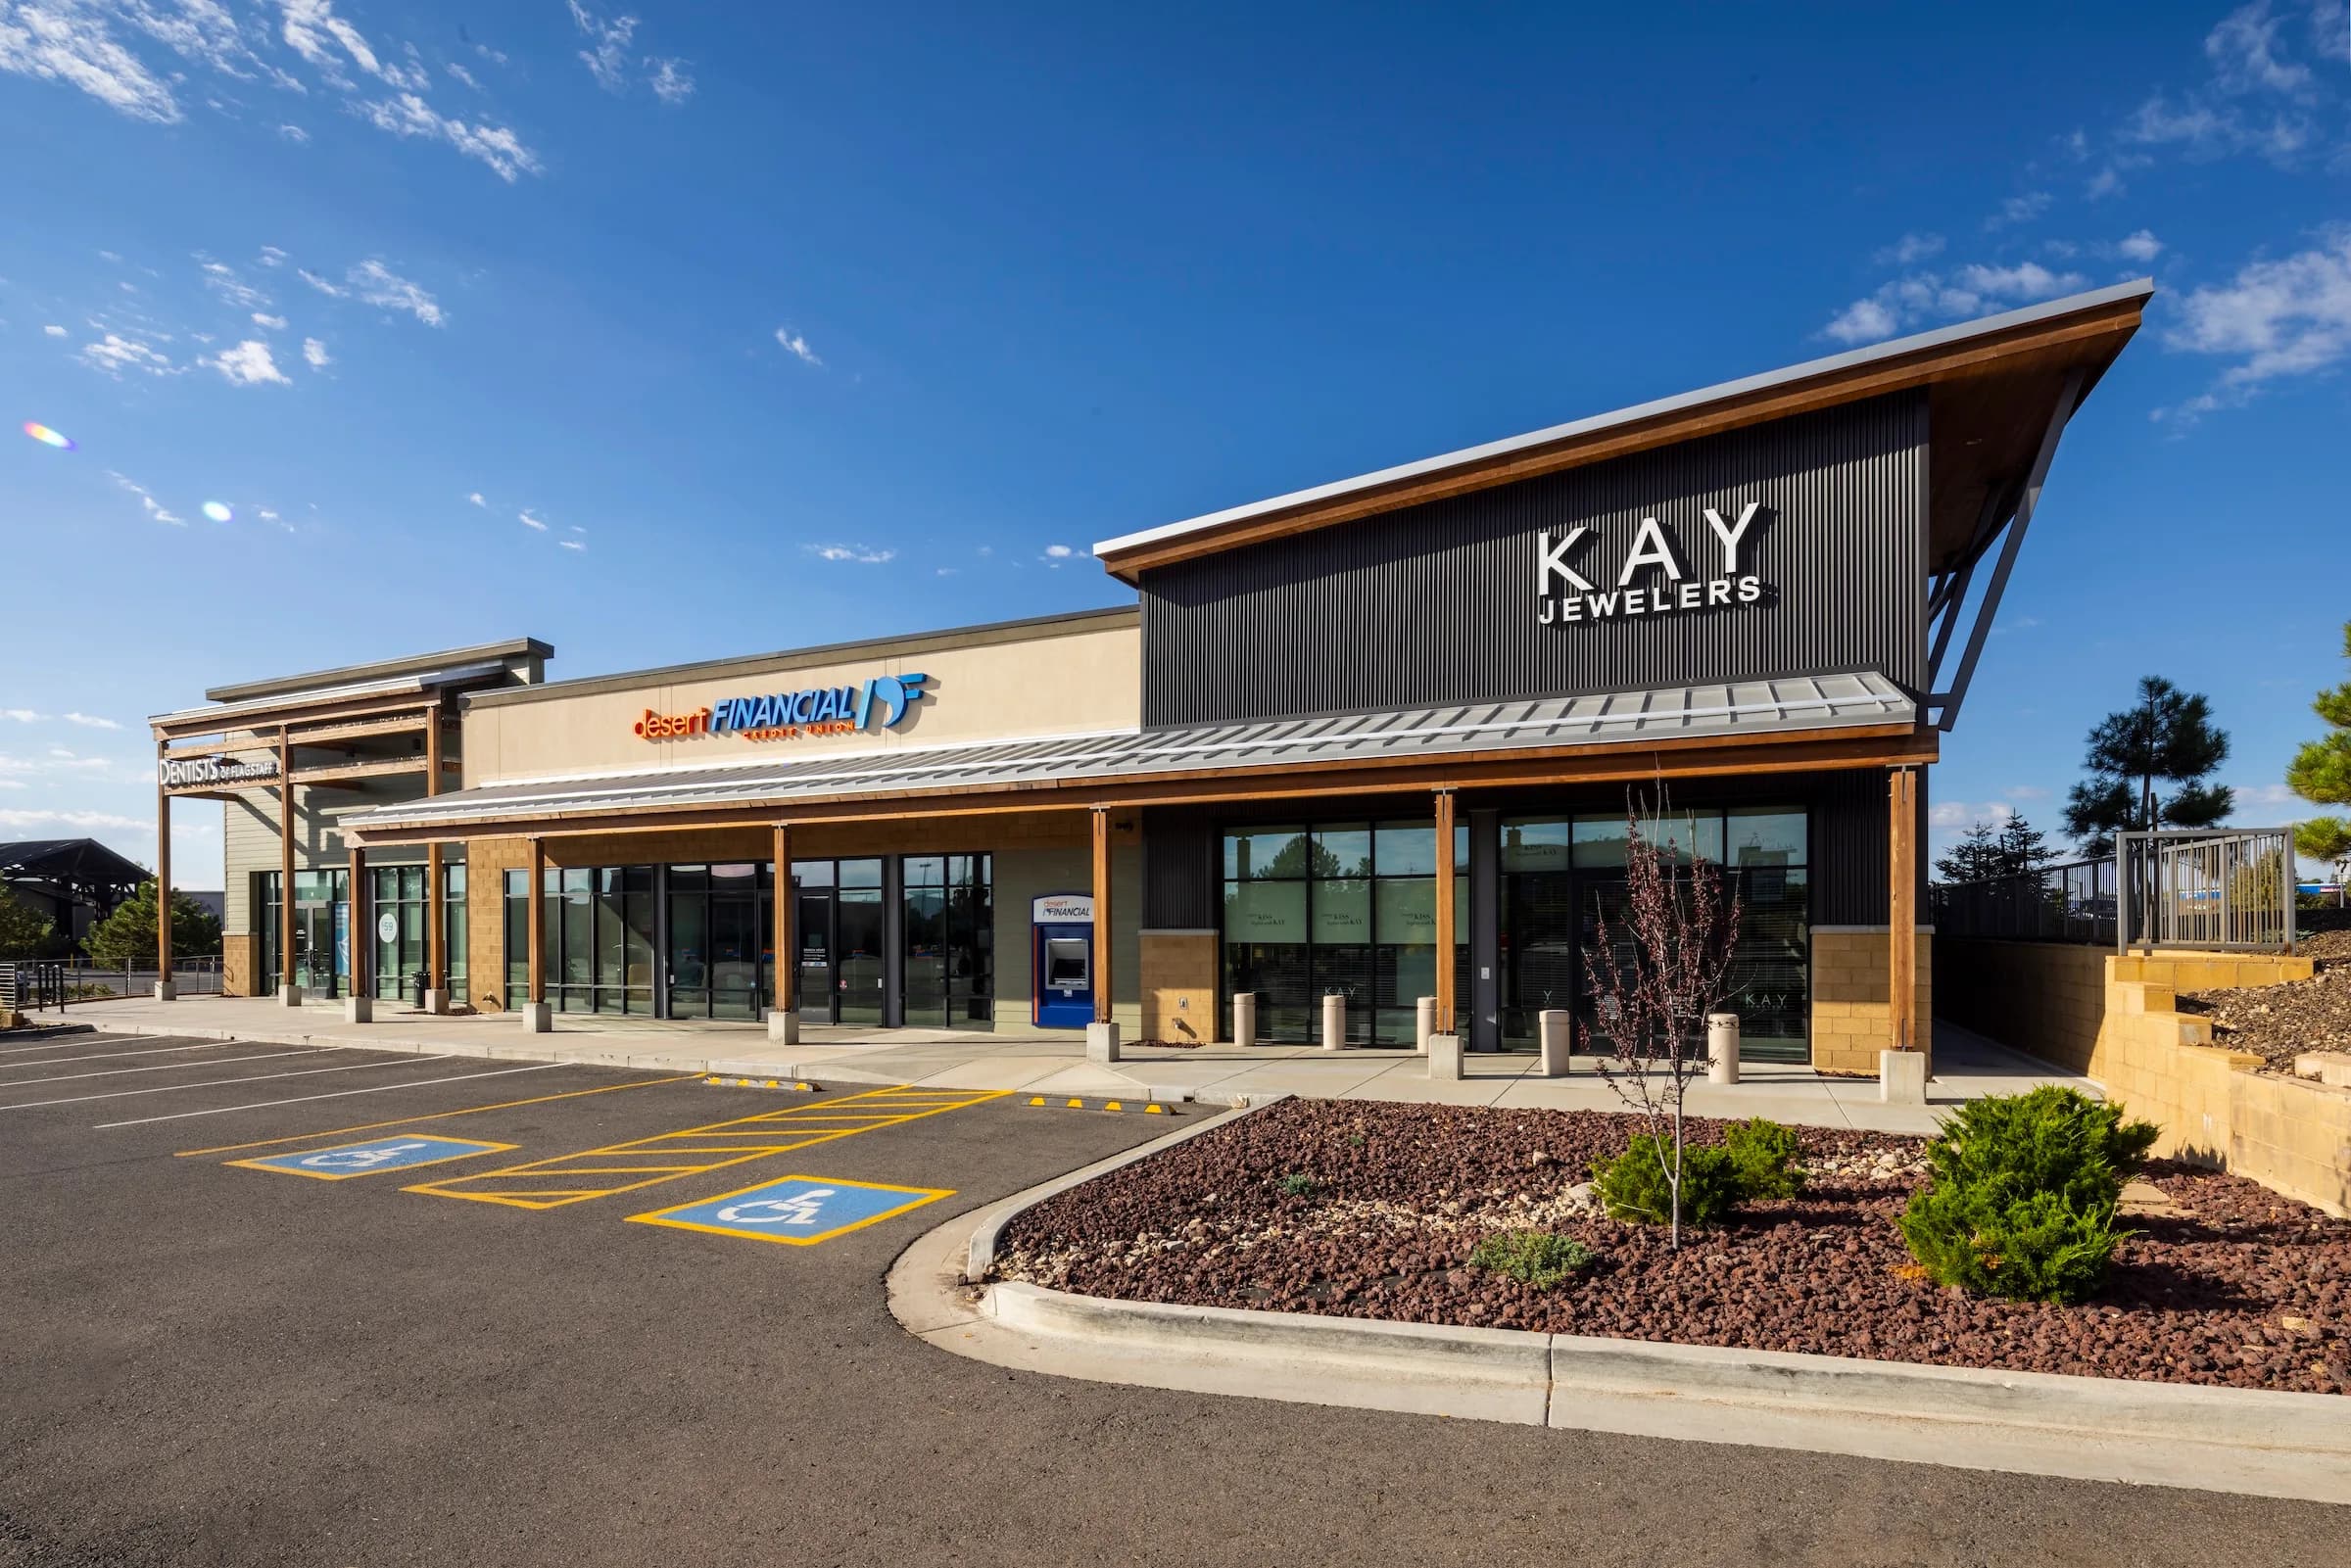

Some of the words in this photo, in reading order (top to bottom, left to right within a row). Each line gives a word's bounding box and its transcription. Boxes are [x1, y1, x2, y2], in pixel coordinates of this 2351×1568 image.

[1538, 501, 1759, 595] KAY
[1539, 576, 1760, 625] JEWELERS
[635, 707, 710, 739] desert
[710, 687, 856, 732] FINANCIAL
[744, 727, 797, 740] CREDIT
[806, 721, 855, 735] UNION
[159, 757, 218, 784] DENTISTS
[231, 762, 273, 777] FLAGSTAFF
[1048, 907, 1090, 917] FINANCIAL
[1324, 986, 1357, 997] KAY
[1746, 994, 1788, 1007] KAY
